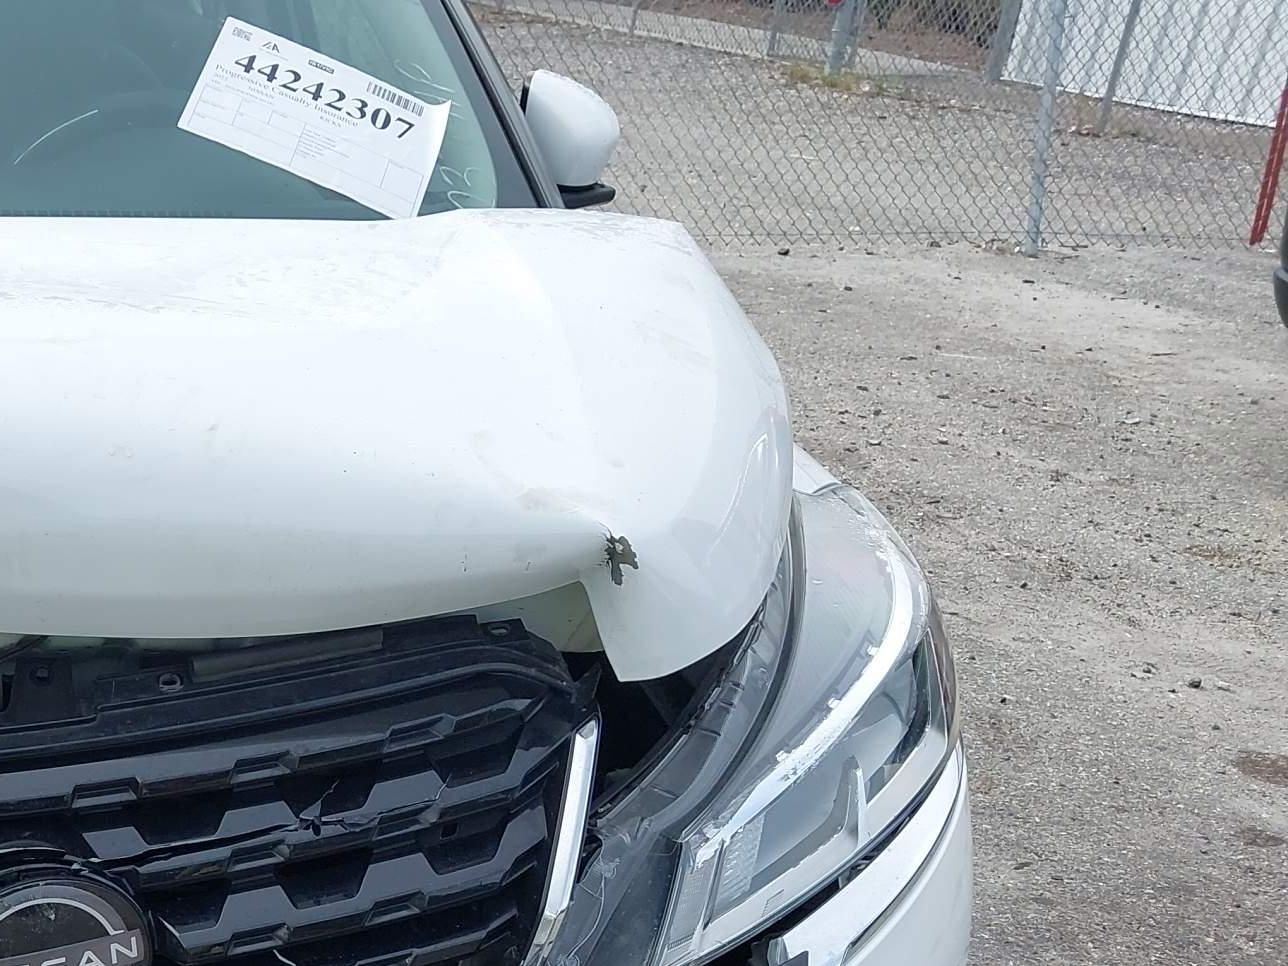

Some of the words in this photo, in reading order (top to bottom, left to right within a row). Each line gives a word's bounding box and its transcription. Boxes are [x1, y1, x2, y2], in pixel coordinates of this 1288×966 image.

[214, 63, 269, 90] Progressive
[270, 85, 312, 108] Casualty
[313, 103, 359, 127] Insurance
[234, 54, 415, 138] 44242307
